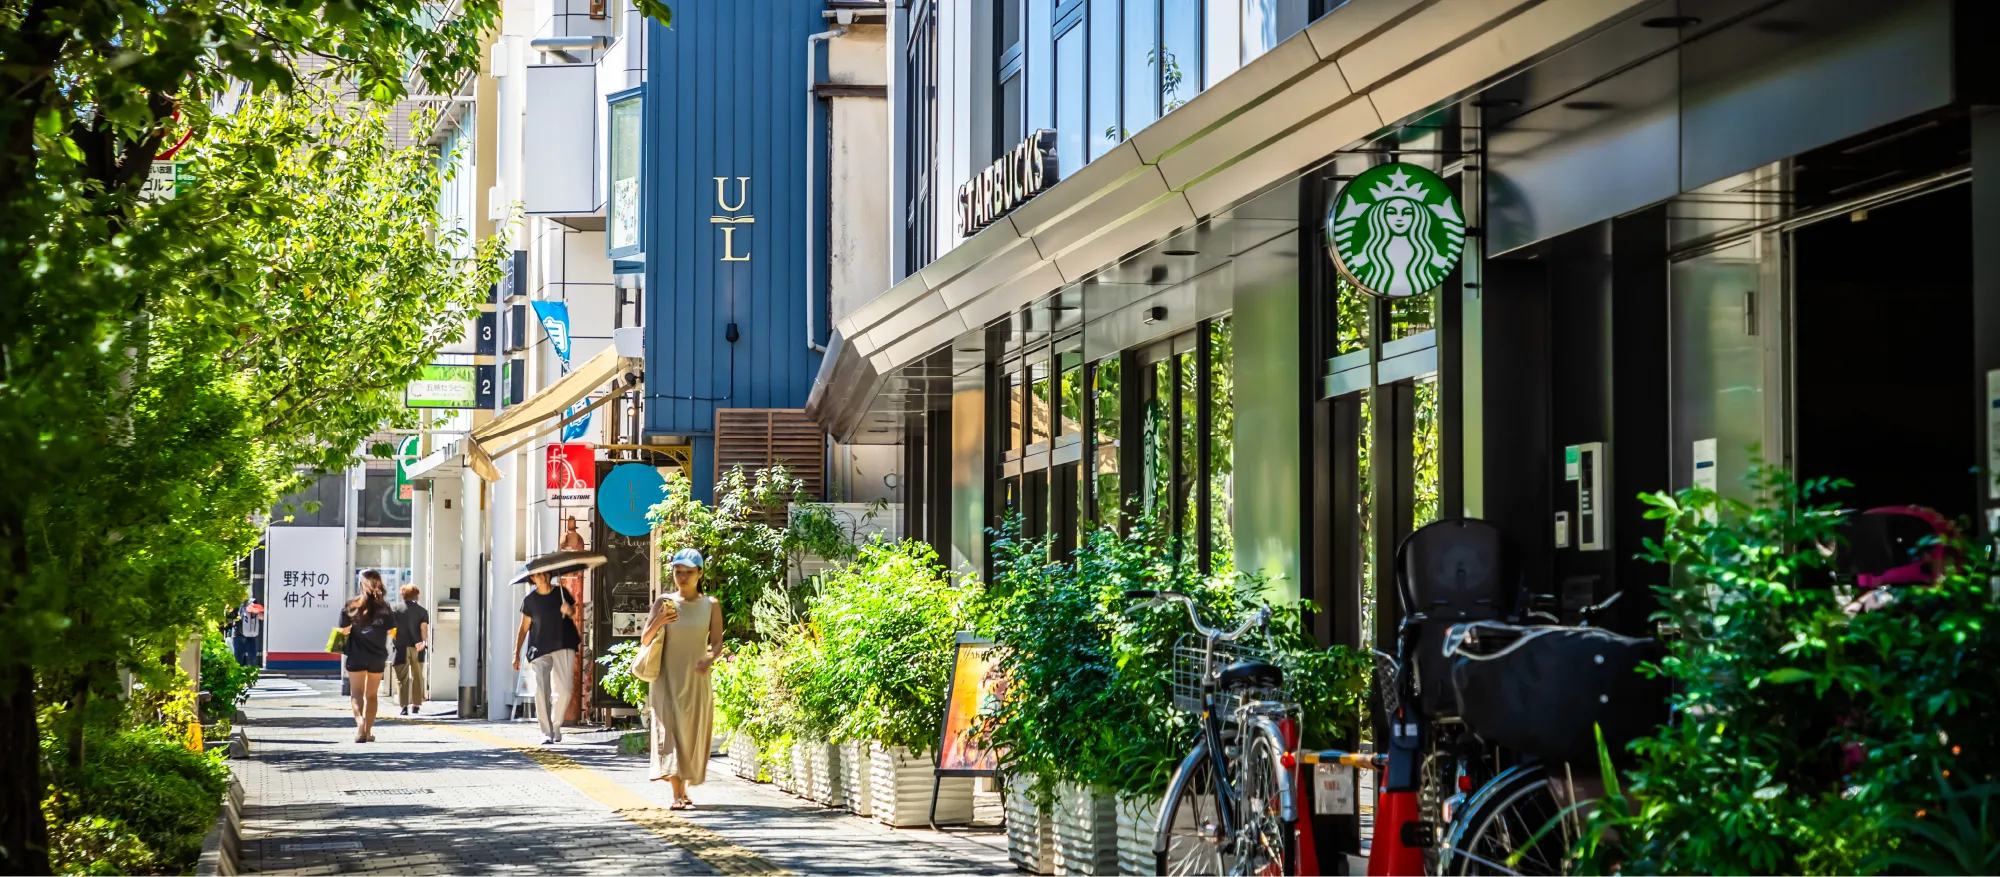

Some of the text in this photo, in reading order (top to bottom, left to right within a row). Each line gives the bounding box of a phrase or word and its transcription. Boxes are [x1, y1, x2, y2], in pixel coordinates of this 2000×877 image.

[713, 177, 750, 211] U
[957, 129, 1045, 239] STARBUCKS
[720, 227, 750, 261] L
[482, 326, 492, 341] 3
[482, 379, 491, 395] 2
[283, 570, 330, 587] 野村の
